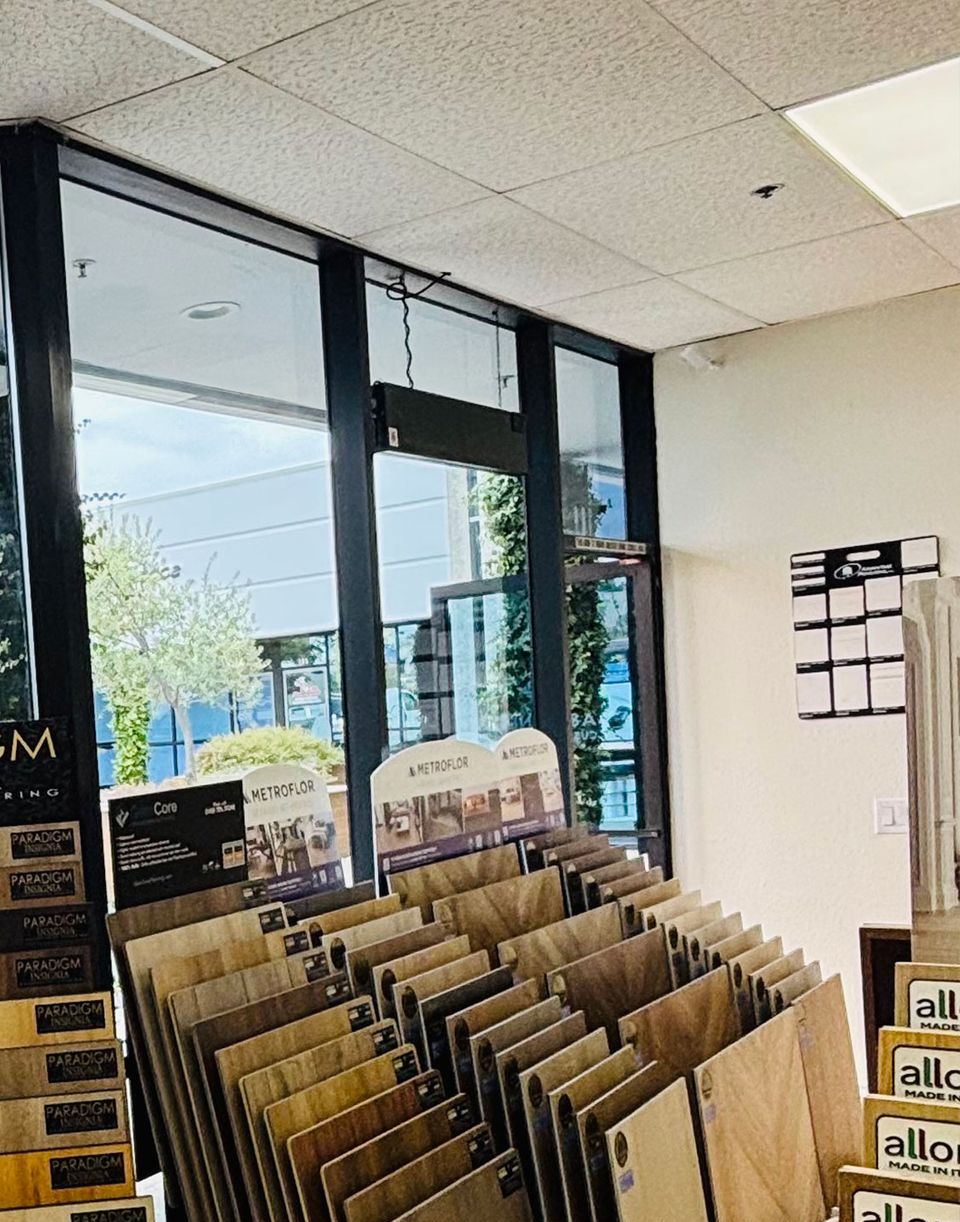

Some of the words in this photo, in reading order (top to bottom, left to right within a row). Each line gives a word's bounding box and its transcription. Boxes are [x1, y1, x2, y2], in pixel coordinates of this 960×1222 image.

[417, 756, 468, 774] METROFLOR
[251, 779, 315, 802] METROFLOR
[154, 801, 178, 815] Core
[12, 830, 72, 845] PARADIGM
[11, 872, 72, 886] PARADIGM
[23, 913, 87, 928] PARADIGM
[17, 958, 81, 972] PARADIGM
[37, 1002, 103, 1018] PARADIGM
[916, 989, 960, 1019] all
[48, 1051, 115, 1067] PARADIGM
[900, 1056, 960, 1090] allo
[905, 1090, 945, 1101] MADE
[46, 1102, 114, 1117] PARADIGM
[884, 1127, 960, 1162] allo
[52, 1155, 122, 1171] PARADIGM
[889, 1161, 930, 1173] MADE
[933, 1166, 948, 1176] IN
